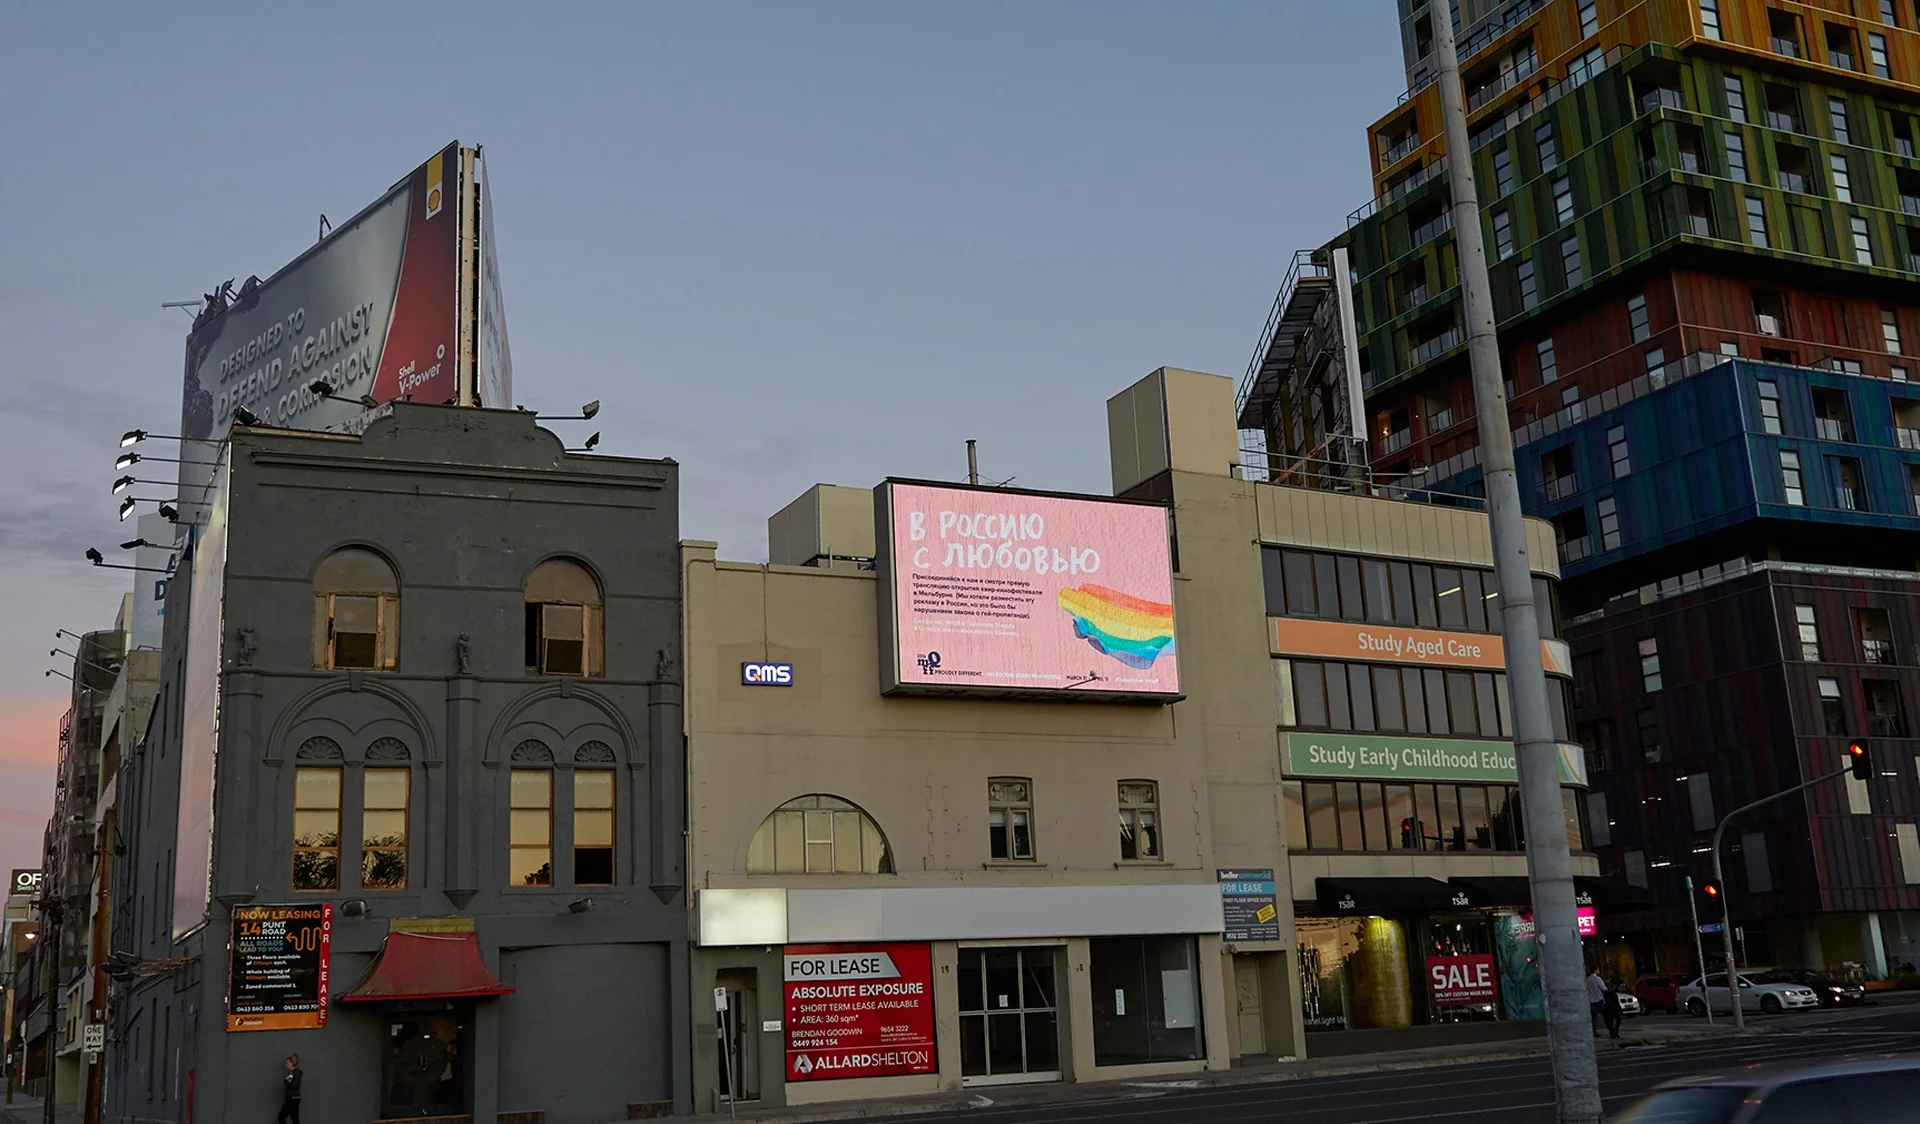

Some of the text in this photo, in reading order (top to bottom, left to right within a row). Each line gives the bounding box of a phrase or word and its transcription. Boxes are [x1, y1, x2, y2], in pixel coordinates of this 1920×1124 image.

[220, 307, 305, 382] DESIGNED TO
[218, 357, 283, 425] DEFEND
[288, 303, 373, 381] AGAINST
[398, 360, 415, 379] Shell
[399, 363, 442, 394] V-Power
[264, 406, 273, 425] &
[909, 510, 1045, 542] В РОССИЮ
[1358, 632, 1481, 659] Study Aged Care
[746, 664, 791, 682] QMS
[1309, 744, 1357, 769] Study
[1359, 747, 1399, 771] Early
[1402, 749, 1478, 769] Childhood
[1222, 884, 1263, 892] FOR LEASE
[240, 909, 321, 920] NOW LEASING
[240, 922, 261, 936] 14
[262, 921, 286, 929] PUNT
[320, 908, 331, 1019] FOR LEASE
[791, 958, 880, 976] FOR LEASE
[1431, 963, 1492, 991] SALE
[791, 983, 923, 999] ABSOLUTE EXPOSURE
[800, 1000, 919, 1013] SHORT TERM LEASE AVAILABLE
[800, 1016, 824, 1024] AREA:
[826, 1015, 839, 1023] 360
[791, 1028, 863, 1038] BRENDAN GOODWIN
